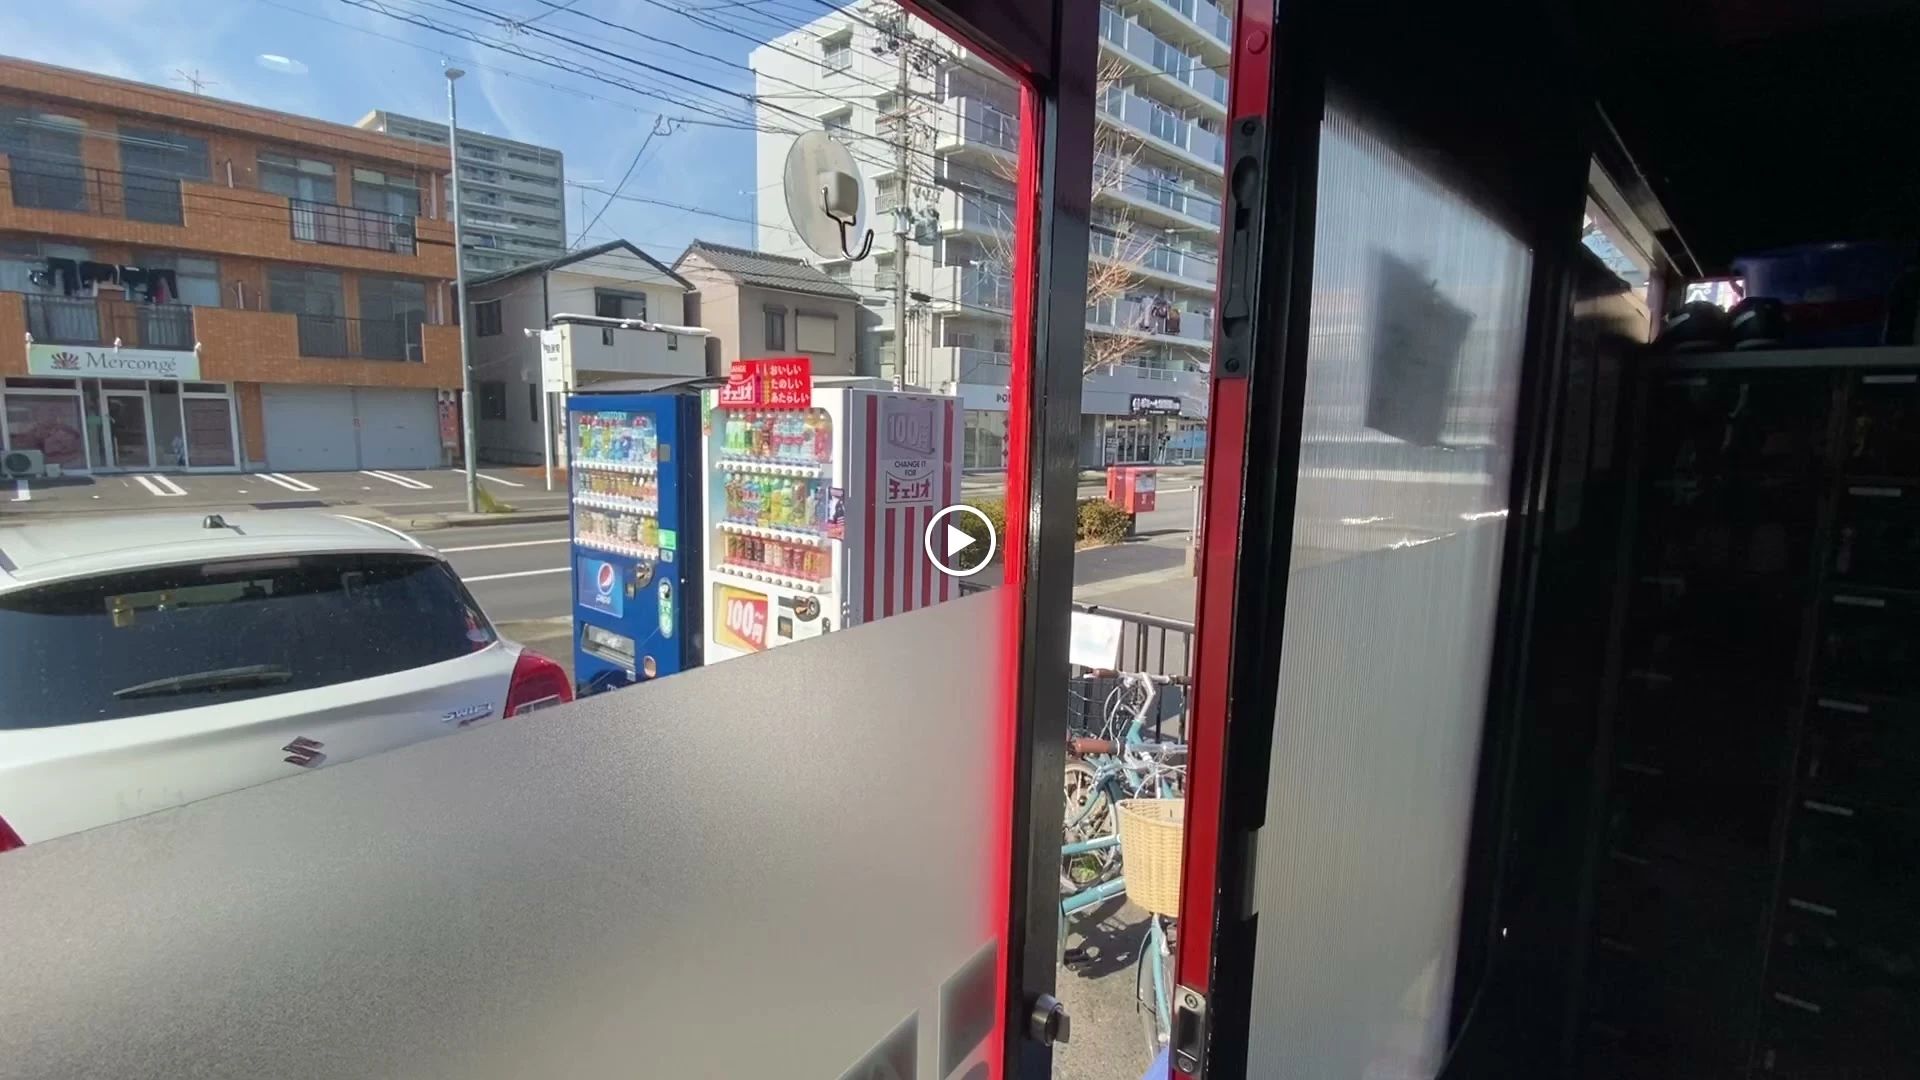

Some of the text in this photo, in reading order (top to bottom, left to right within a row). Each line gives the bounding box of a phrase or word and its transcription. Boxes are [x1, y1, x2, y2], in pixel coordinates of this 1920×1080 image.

[85, 352, 177, 373] Mercongé
[769, 363, 803, 376] おいしい
[770, 379, 804, 390] たのしい
[770, 392, 810, 404] あたらしい
[894, 460, 920, 469] CHANGE
[904, 469, 917, 477] FOR
[889, 478, 930, 500] チェリオ
[441, 702, 493, 722] SWIFT
